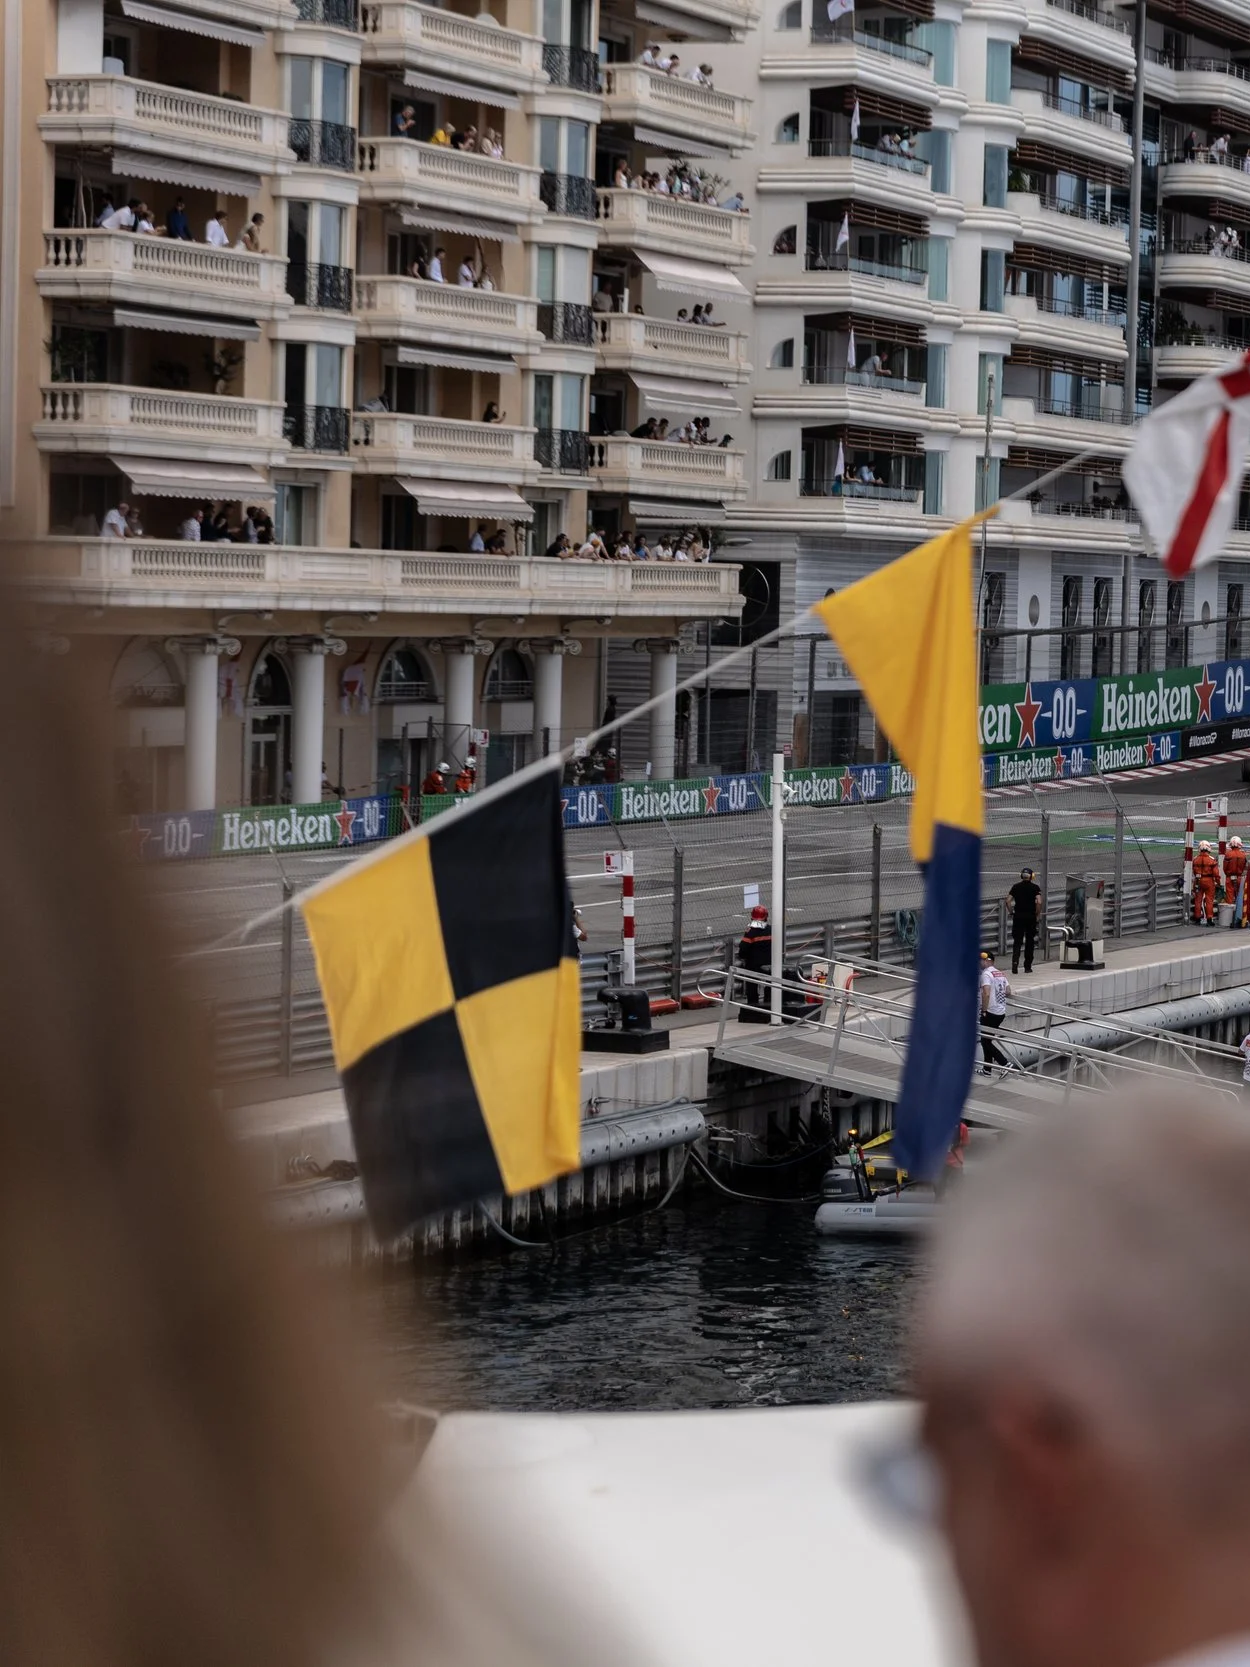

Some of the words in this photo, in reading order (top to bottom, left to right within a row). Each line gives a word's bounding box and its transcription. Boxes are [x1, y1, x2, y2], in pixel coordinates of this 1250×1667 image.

[1101, 677, 1192, 733] Heineken
[998, 753, 1052, 782] Heineken
[1096, 741, 1144, 771] Heineken
[620, 784, 700, 819] Heineken
[222, 808, 333, 850] Heineken
